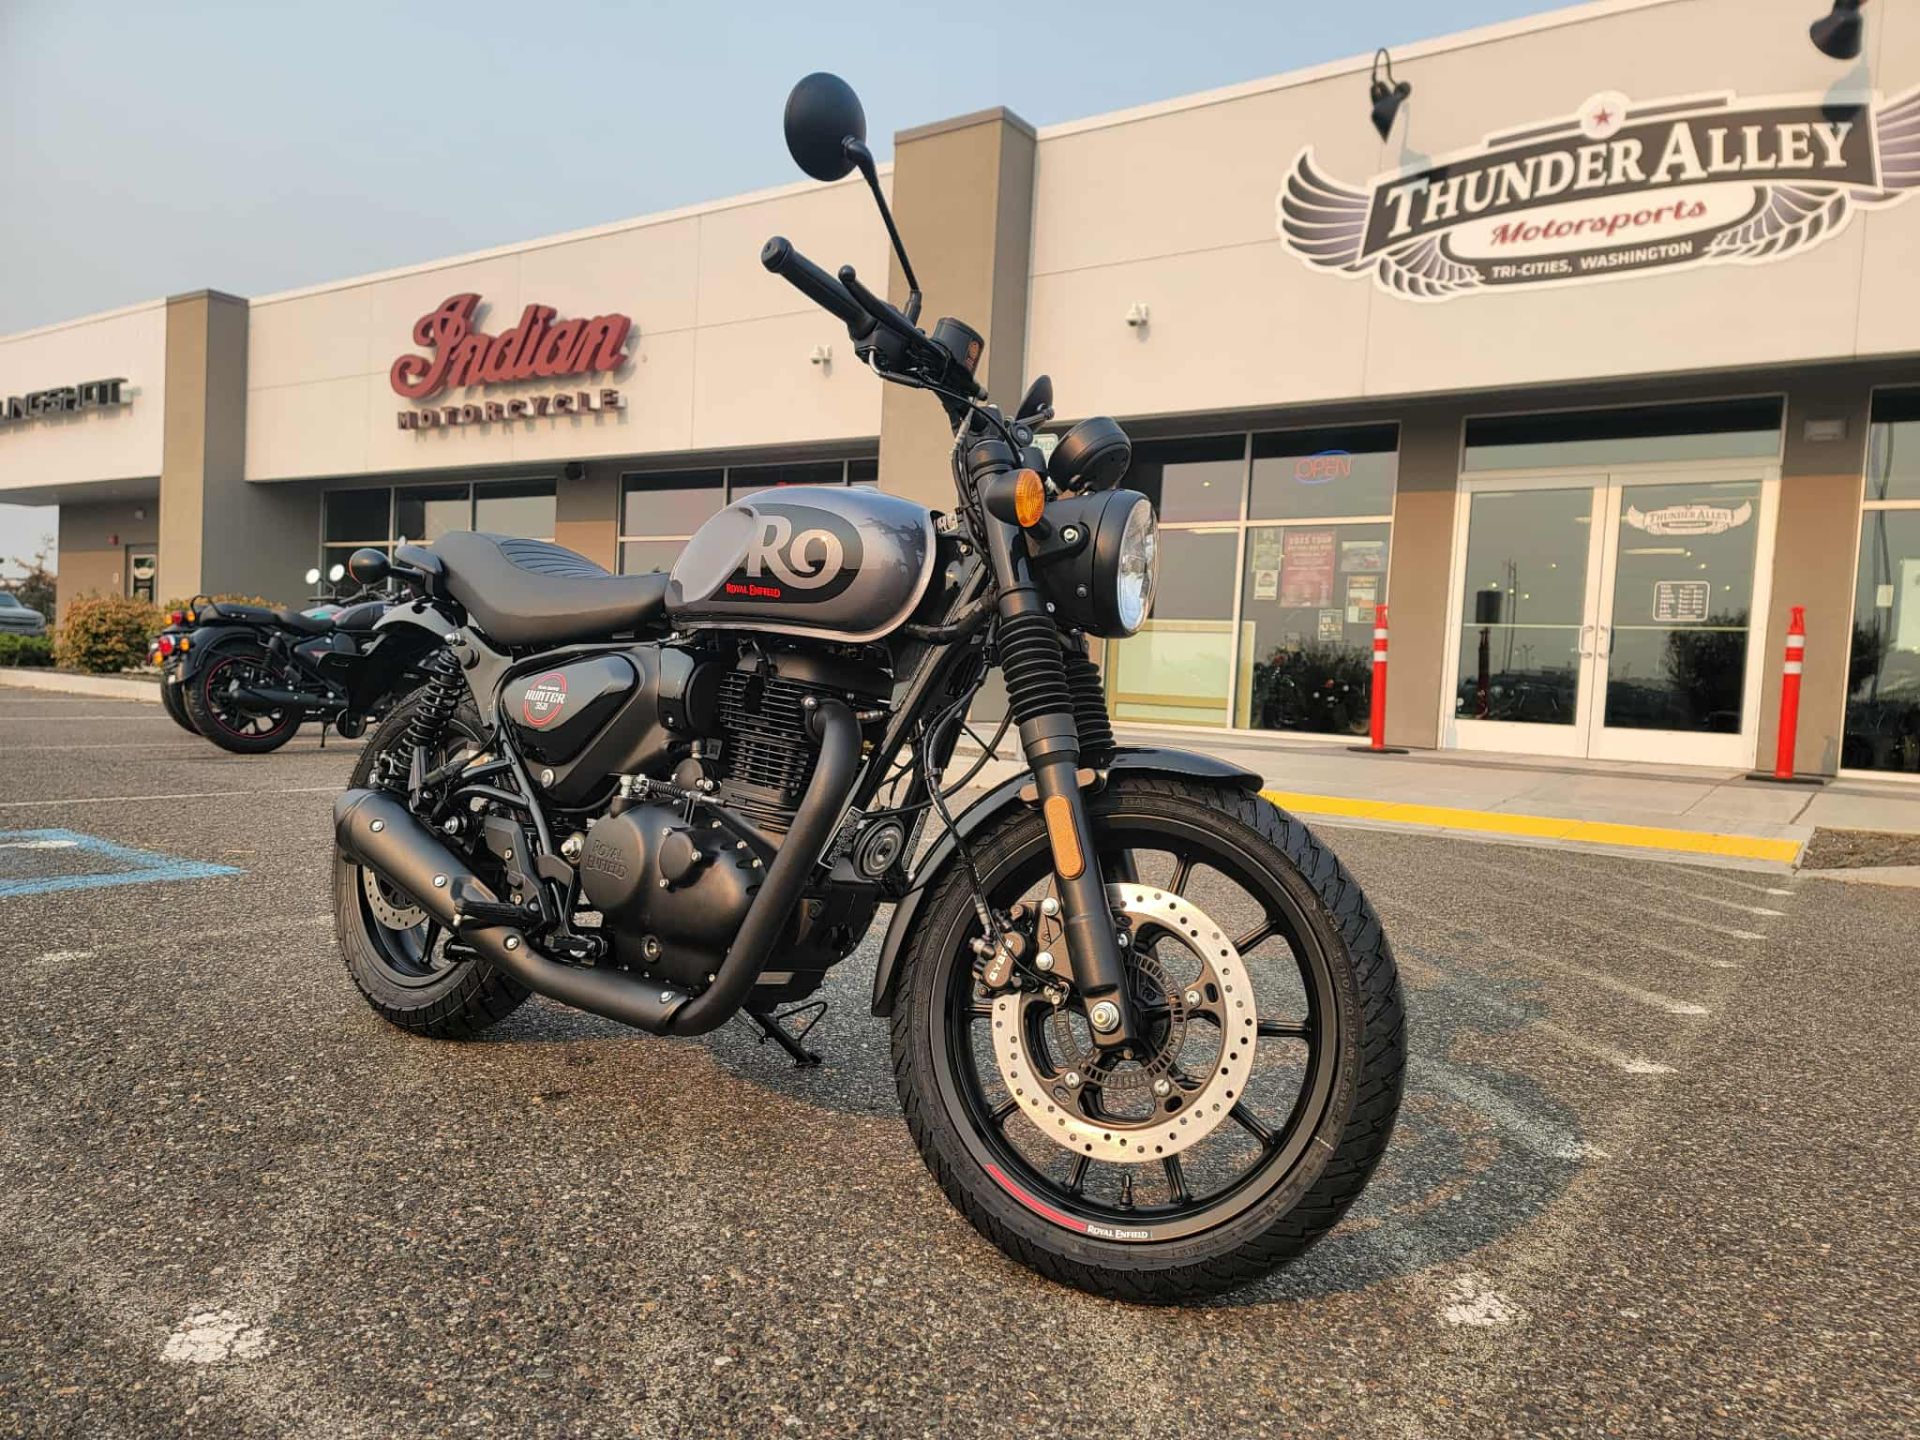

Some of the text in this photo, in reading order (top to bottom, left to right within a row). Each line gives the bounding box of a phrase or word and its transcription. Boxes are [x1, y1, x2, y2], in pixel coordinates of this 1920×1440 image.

[1386, 120, 1854, 239] THUNDER ALLEY
[1490, 199, 1708, 246] Motorsports
[1492, 239, 1694, 279] TRI-CITIES, WASHINGTON
[390, 292, 632, 399] Indian
[397, 388, 625, 430] MOTORCYCLE
[1294, 456, 1351, 479] OPEN
[726, 582, 781, 599] ROYAL ENFIELD
[524, 689, 566, 705] HUNTER
[1087, 1223, 1149, 1239] ROYAL ENFIELD
